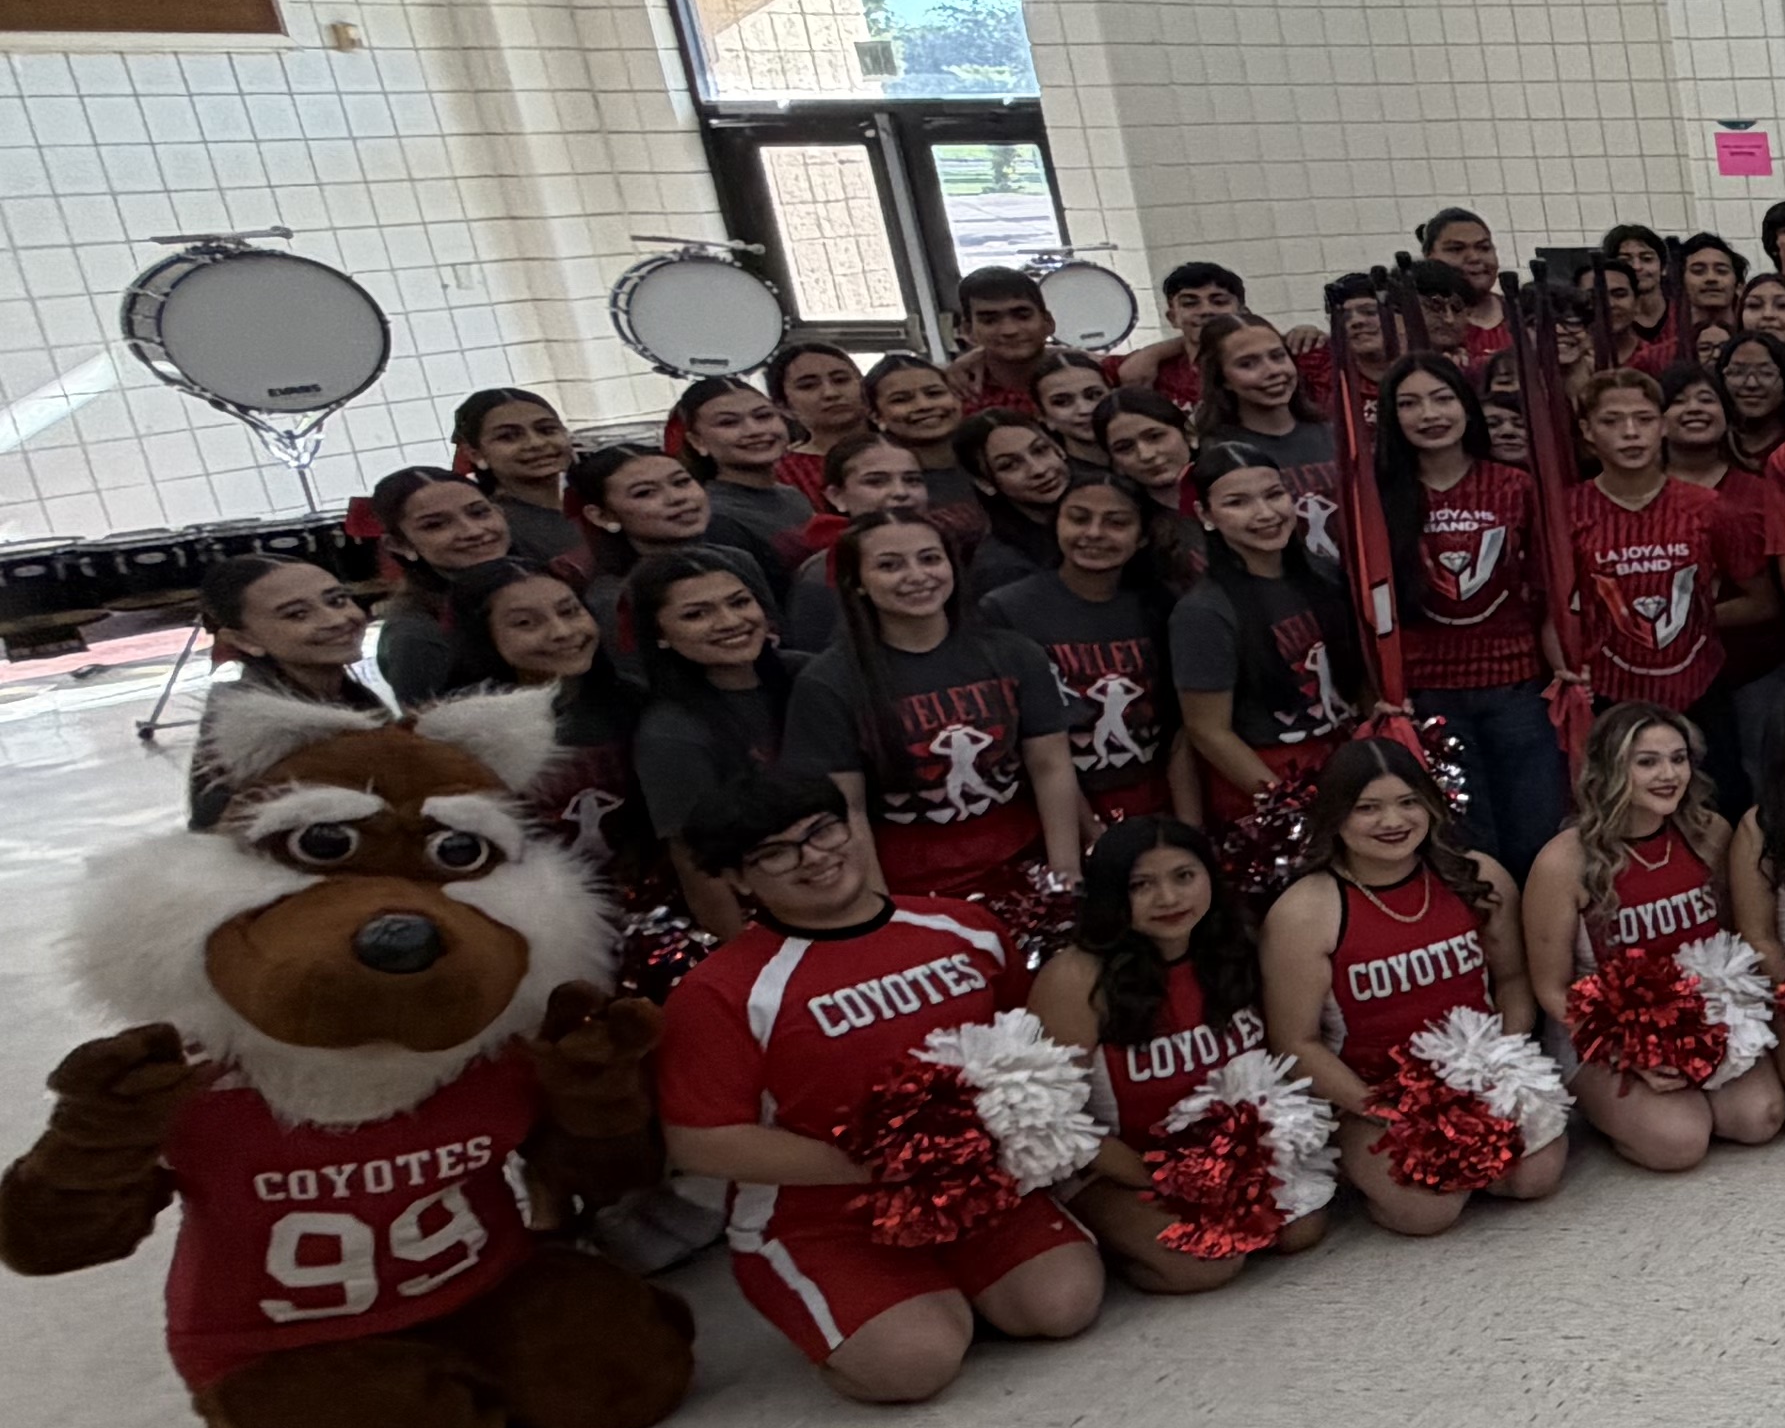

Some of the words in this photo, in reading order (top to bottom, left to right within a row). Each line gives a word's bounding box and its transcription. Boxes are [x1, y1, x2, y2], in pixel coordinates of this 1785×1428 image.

[1595, 550, 1619, 564] LA
[1622, 545, 1666, 561] JOYA
[1667, 543, 1689, 556] HS
[1616, 559, 1671, 576] BAND
[808, 953, 988, 1037] COYOTES
[1347, 929, 1484, 1002] COYOTES
[253, 1135, 493, 1201] COYOTES
[259, 1179, 488, 1323] 99
